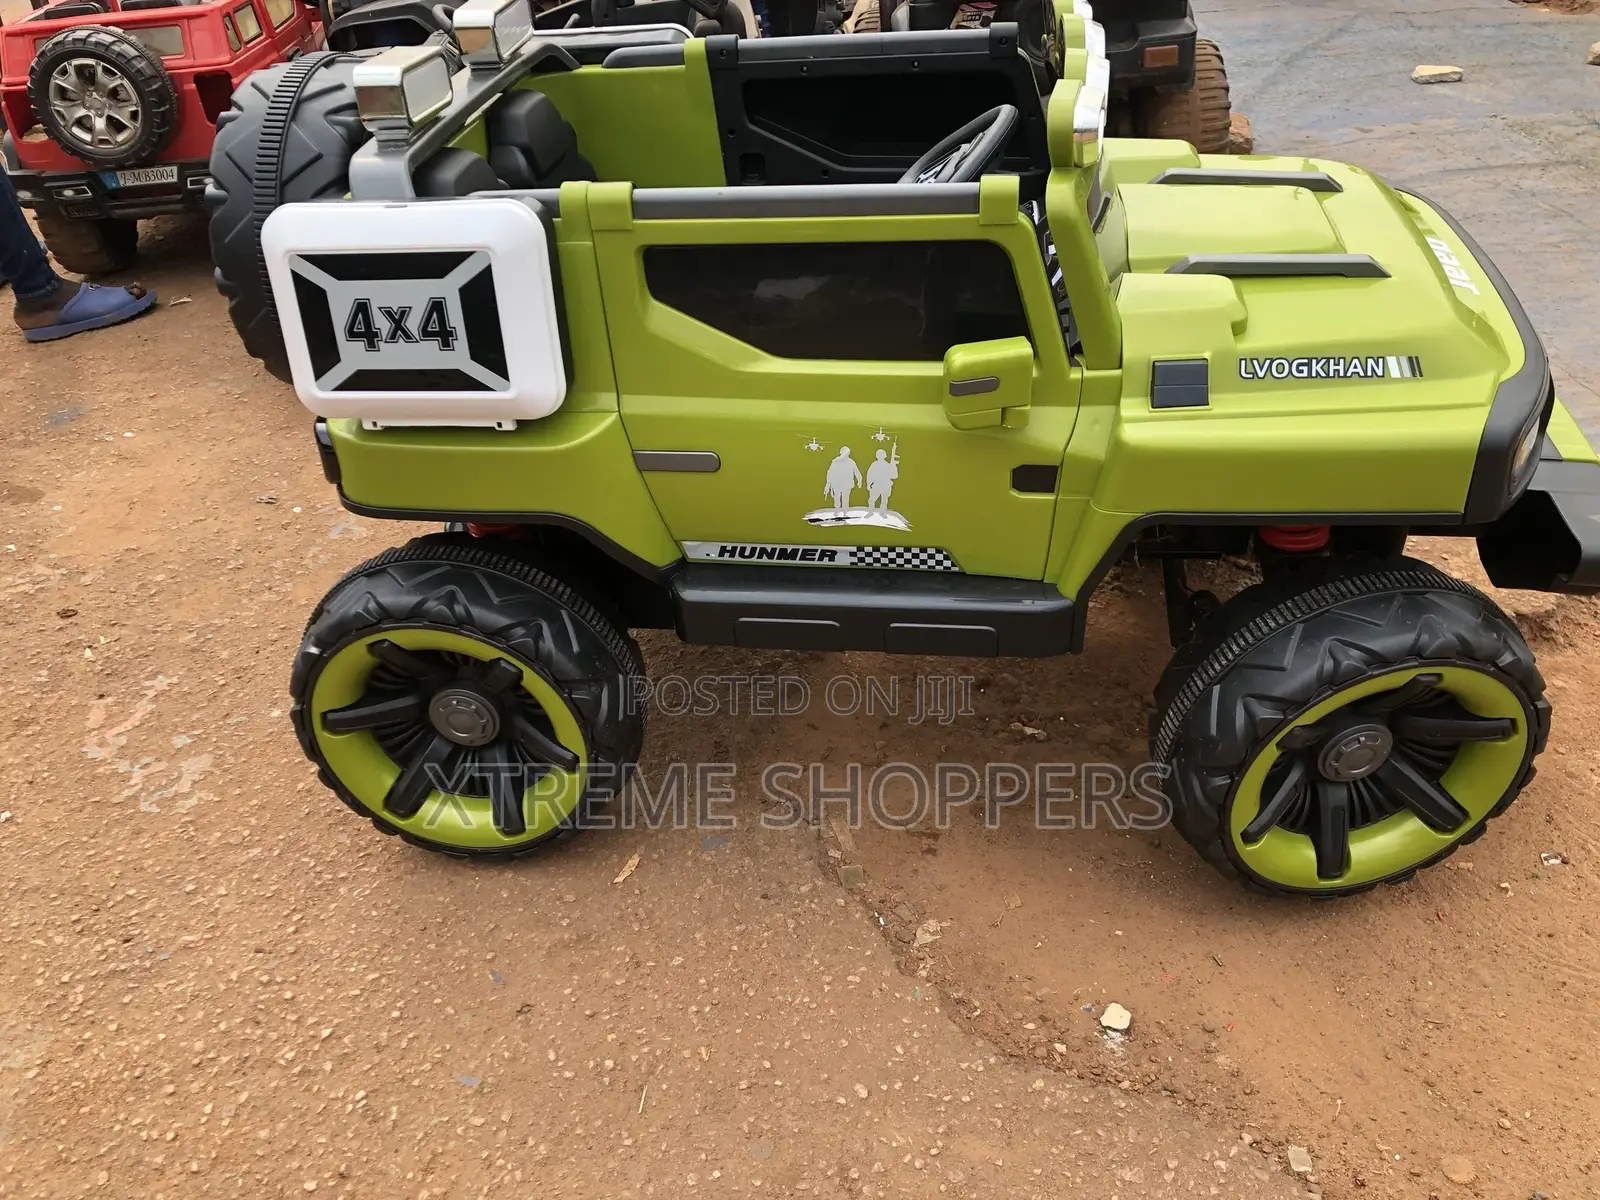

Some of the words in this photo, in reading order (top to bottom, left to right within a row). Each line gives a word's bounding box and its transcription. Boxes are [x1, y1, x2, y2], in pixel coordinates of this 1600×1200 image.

[344, 297, 458, 352] 4x4
[1239, 356, 1385, 379] LVOGKHAN
[718, 545, 838, 562] HUNMER
